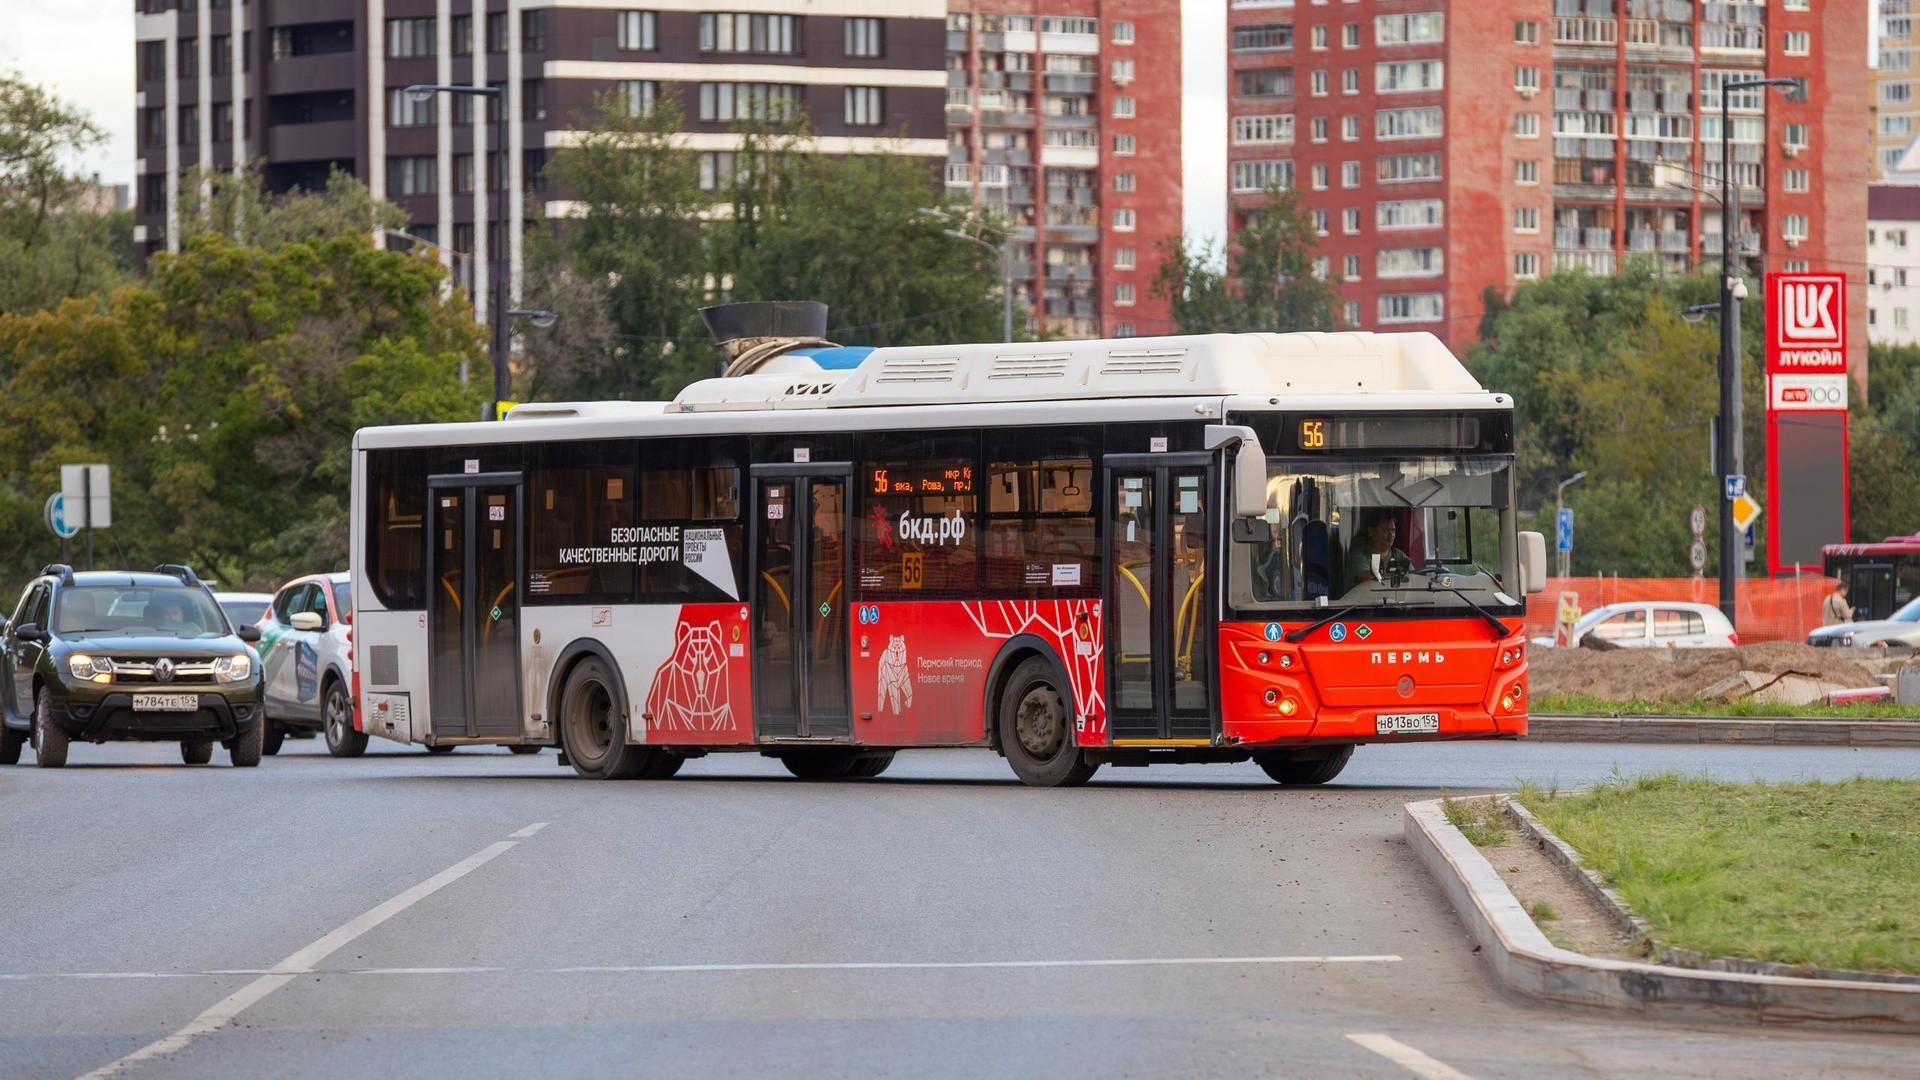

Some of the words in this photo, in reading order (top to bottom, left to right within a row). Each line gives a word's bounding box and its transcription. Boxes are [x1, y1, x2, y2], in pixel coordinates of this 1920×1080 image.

[1779, 349, 1842, 367] ЛУКОЙЛ
[1808, 387, 1841, 403] 100
[1304, 421, 1323, 447] 56
[874, 470, 888, 493] 56
[894, 482, 913, 492] вка,
[611, 527, 680, 543] БЕЗОПАСНЫЕ
[899, 509, 966, 546] бкд.рф
[685, 542, 707, 552] ПРОЕКТЫ
[559, 547, 637, 564] КАЧЕСТВЕННЫЕ
[638, 546, 679, 566] ДОРОГИ
[685, 553, 703, 563] РОССИИ
[904, 558, 920, 583] 56
[917, 656, 953, 670] Пермский
[954, 658, 983, 670] период
[1371, 652, 1445, 664] ПЕРМЬ
[917, 673, 940, 683] Новое
[942, 674, 965, 686] время
[136, 696, 177, 707] М784ТЕ
[1380, 716, 1420, 729] Н813ВО
[1422, 715, 1436, 725] 159
